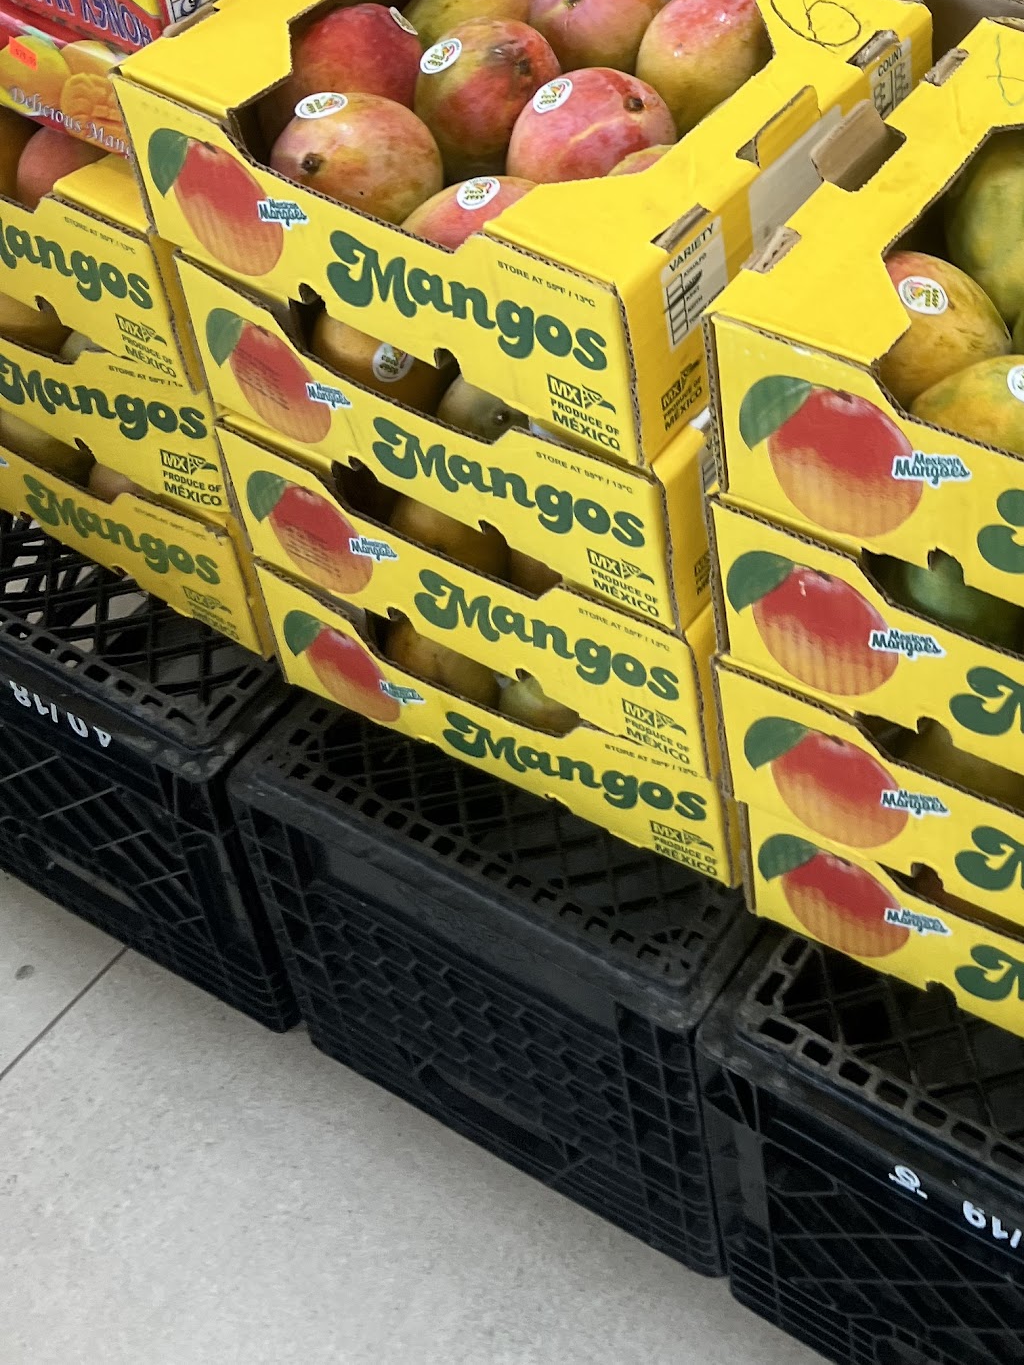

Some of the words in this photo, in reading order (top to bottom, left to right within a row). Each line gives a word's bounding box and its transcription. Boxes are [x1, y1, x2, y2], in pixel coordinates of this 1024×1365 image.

[8, 85, 82, 132] Delicious
[258, 203, 308, 227] Mangoes
[669, 222, 715, 273] VARIETY
[0, 217, 153, 310] angos
[497, 260, 530, 281] STORE
[532, 273, 543, 285] AT
[326, 229, 608, 372] Mangos
[0, 354, 208, 440] Mangos
[550, 377, 581, 405] MX
[550, 397, 603, 430] PRODUCE
[604, 422, 620, 436] OF
[552, 411, 621, 452] MÉXICO
[163, 452, 188, 473] MX
[535, 451, 568, 469] STORE
[570, 463, 581, 474] AT
[894, 459, 971, 485] Mangoes
[913, 453, 962, 469] Mexican
[163, 470, 205, 490] PRODUCE
[208, 483, 222, 493] OF
[164, 481, 222, 507] MÉXICO
[372, 415, 646, 549] Mangos
[23, 473, 221, 586] Mangos
[590, 551, 620, 577] MX
[591, 567, 642, 597] PRODUCE
[644, 592, 658, 604] OF
[593, 578, 660, 618] MÉXICO
[578, 607, 608, 625] STORE
[610, 621, 621, 631] AT
[413, 568, 680, 702] Mangos
[871, 633, 942, 657] Mangoes
[624, 702, 654, 726] MX
[624, 717, 674, 745] PRODUCE
[676, 739, 690, 753] OF
[626, 727, 690, 765] MÉXICO
[443, 711, 707, 821] Mangos
[604, 743, 635, 760] STORE
[652, 822, 681, 843] MX
[653, 836, 702, 862] PRODUCE
[704, 855, 718, 866] OF
